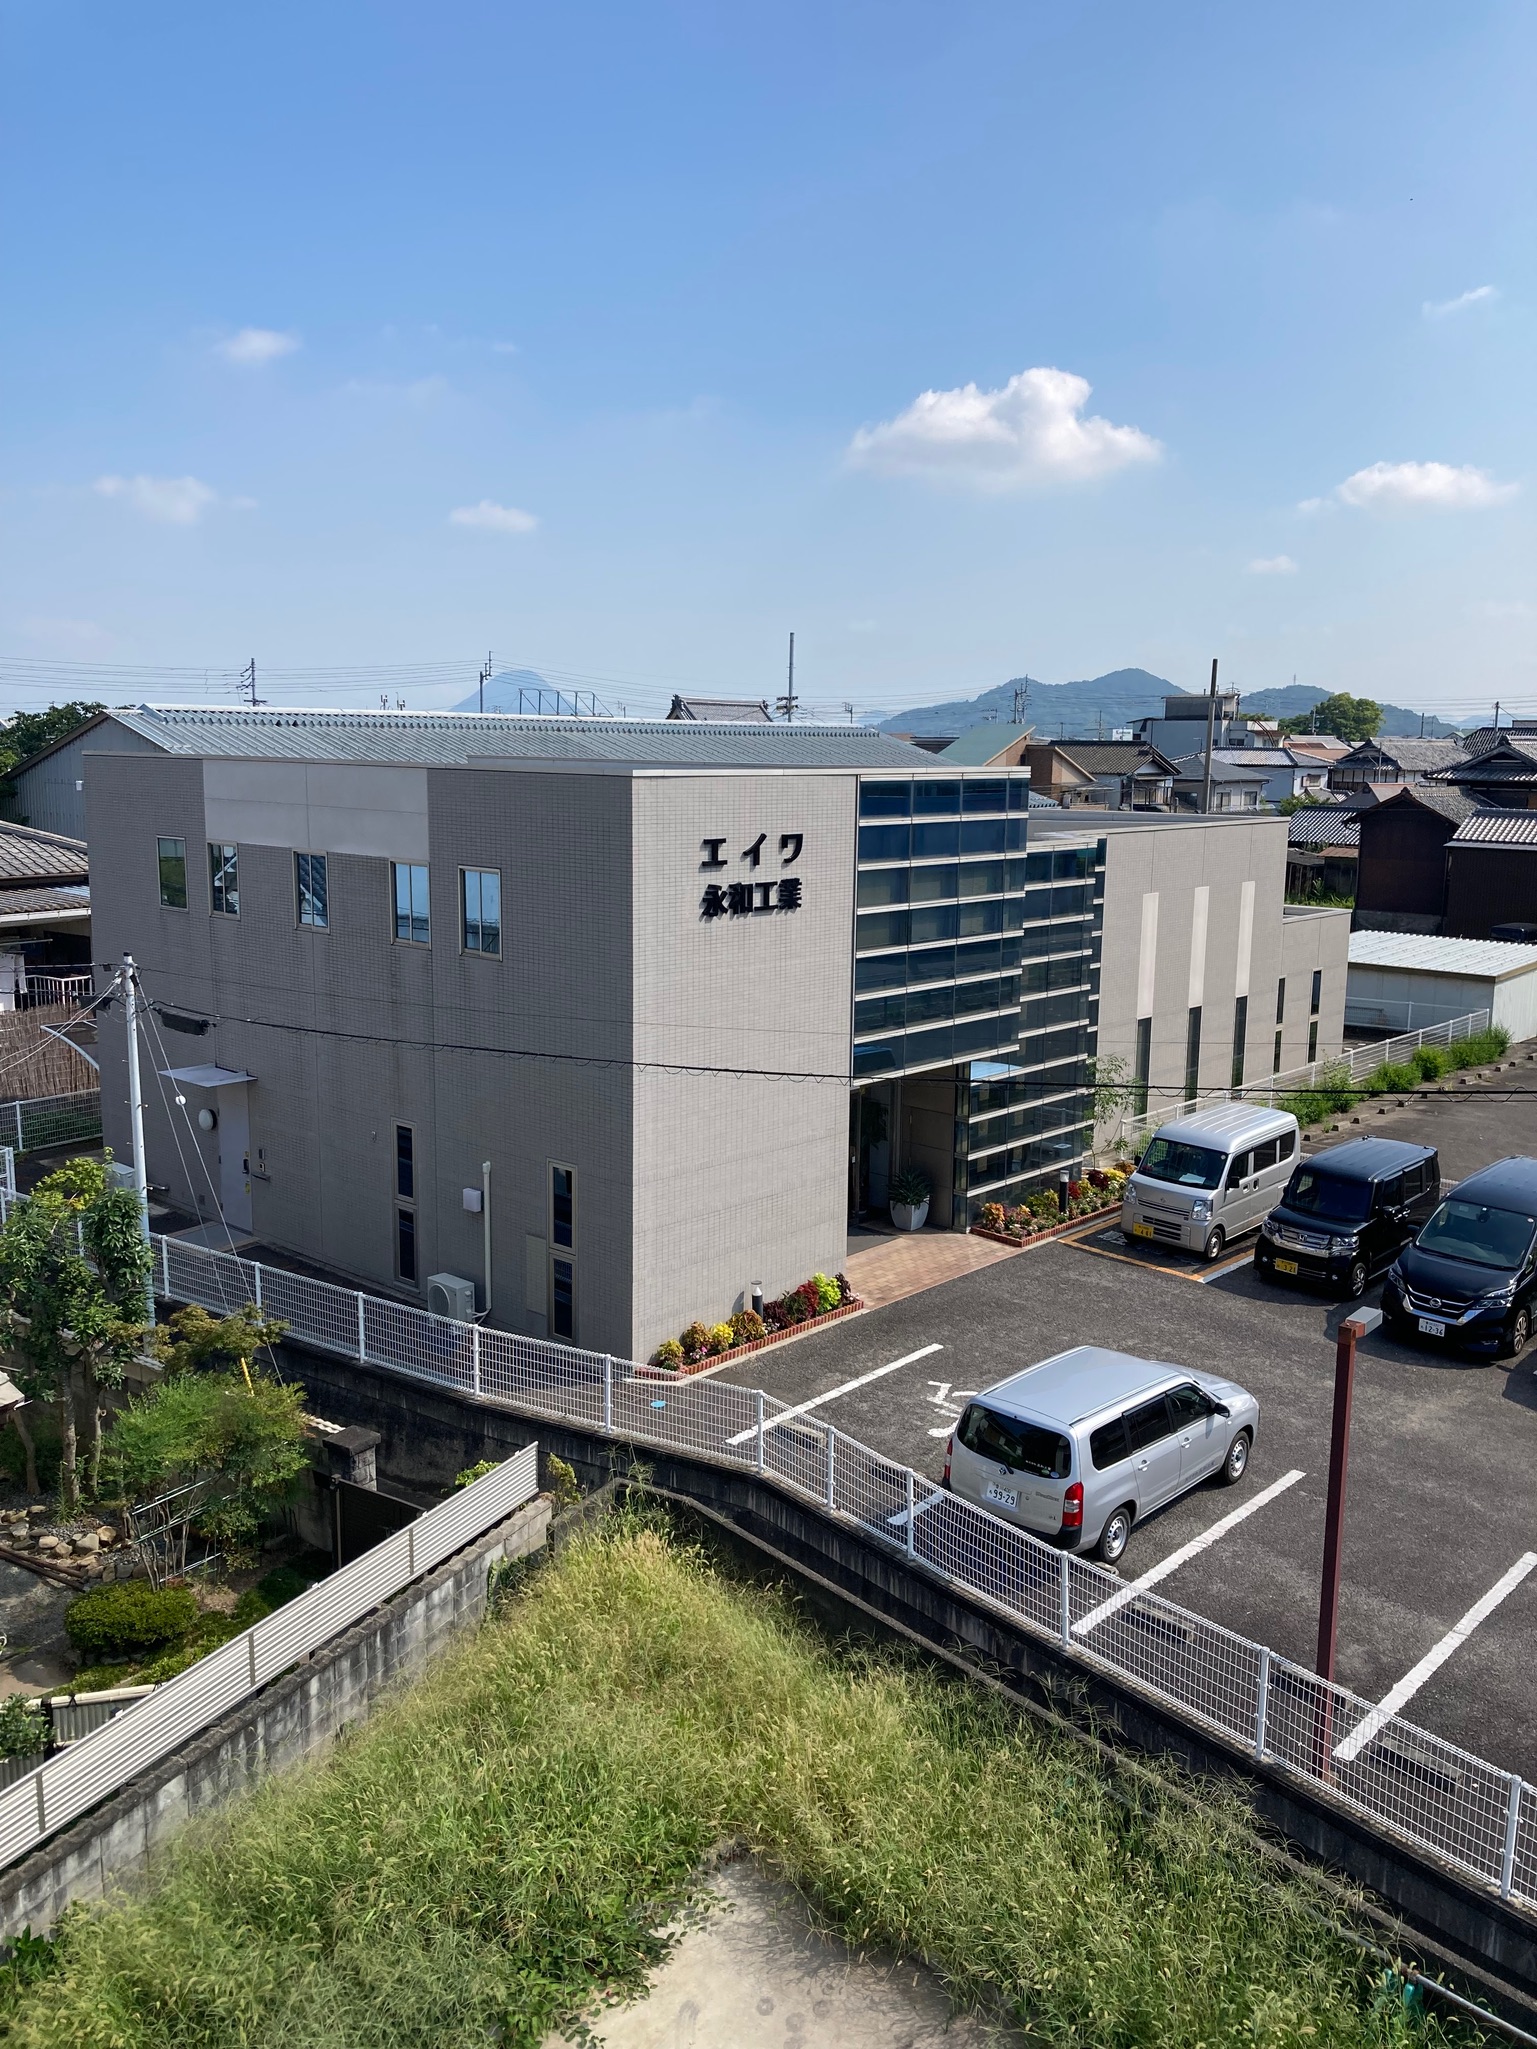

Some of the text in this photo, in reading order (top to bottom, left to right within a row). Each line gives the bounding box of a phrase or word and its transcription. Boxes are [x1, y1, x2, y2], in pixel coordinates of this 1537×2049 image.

[702, 833, 803, 867] エイワ
[701, 878, 803, 918] 永和工業
[993, 1489, 1016, 1506] 99-29
